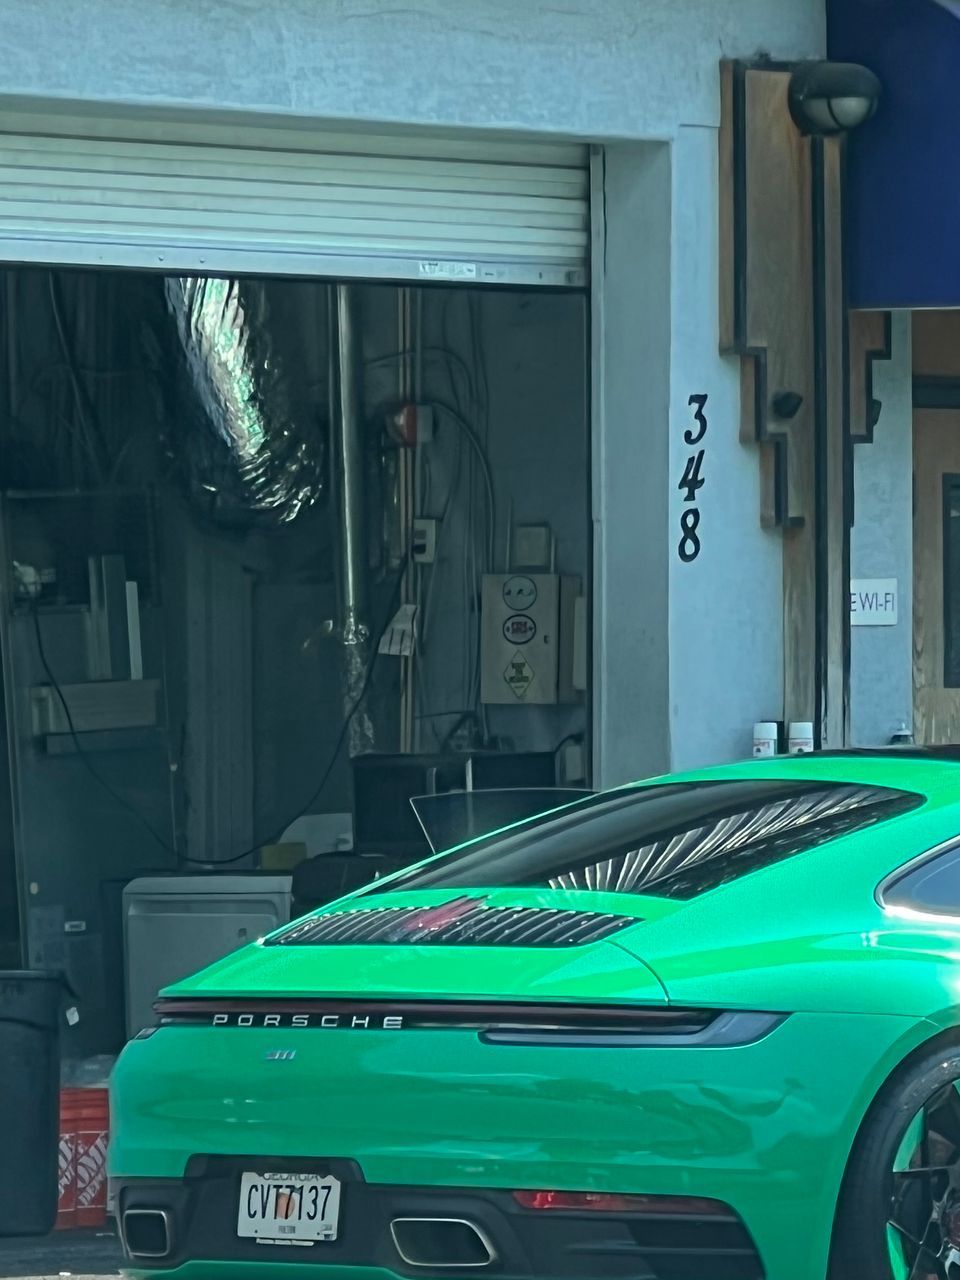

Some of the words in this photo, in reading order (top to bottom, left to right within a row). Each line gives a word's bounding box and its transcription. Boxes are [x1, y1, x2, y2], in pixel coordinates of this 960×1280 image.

[678, 393, 708, 563] 348
[859, 592, 895, 612] WI-FI
[212, 1014, 403, 1029] PORSCHE
[247, 1184, 332, 1221] CVT7137
